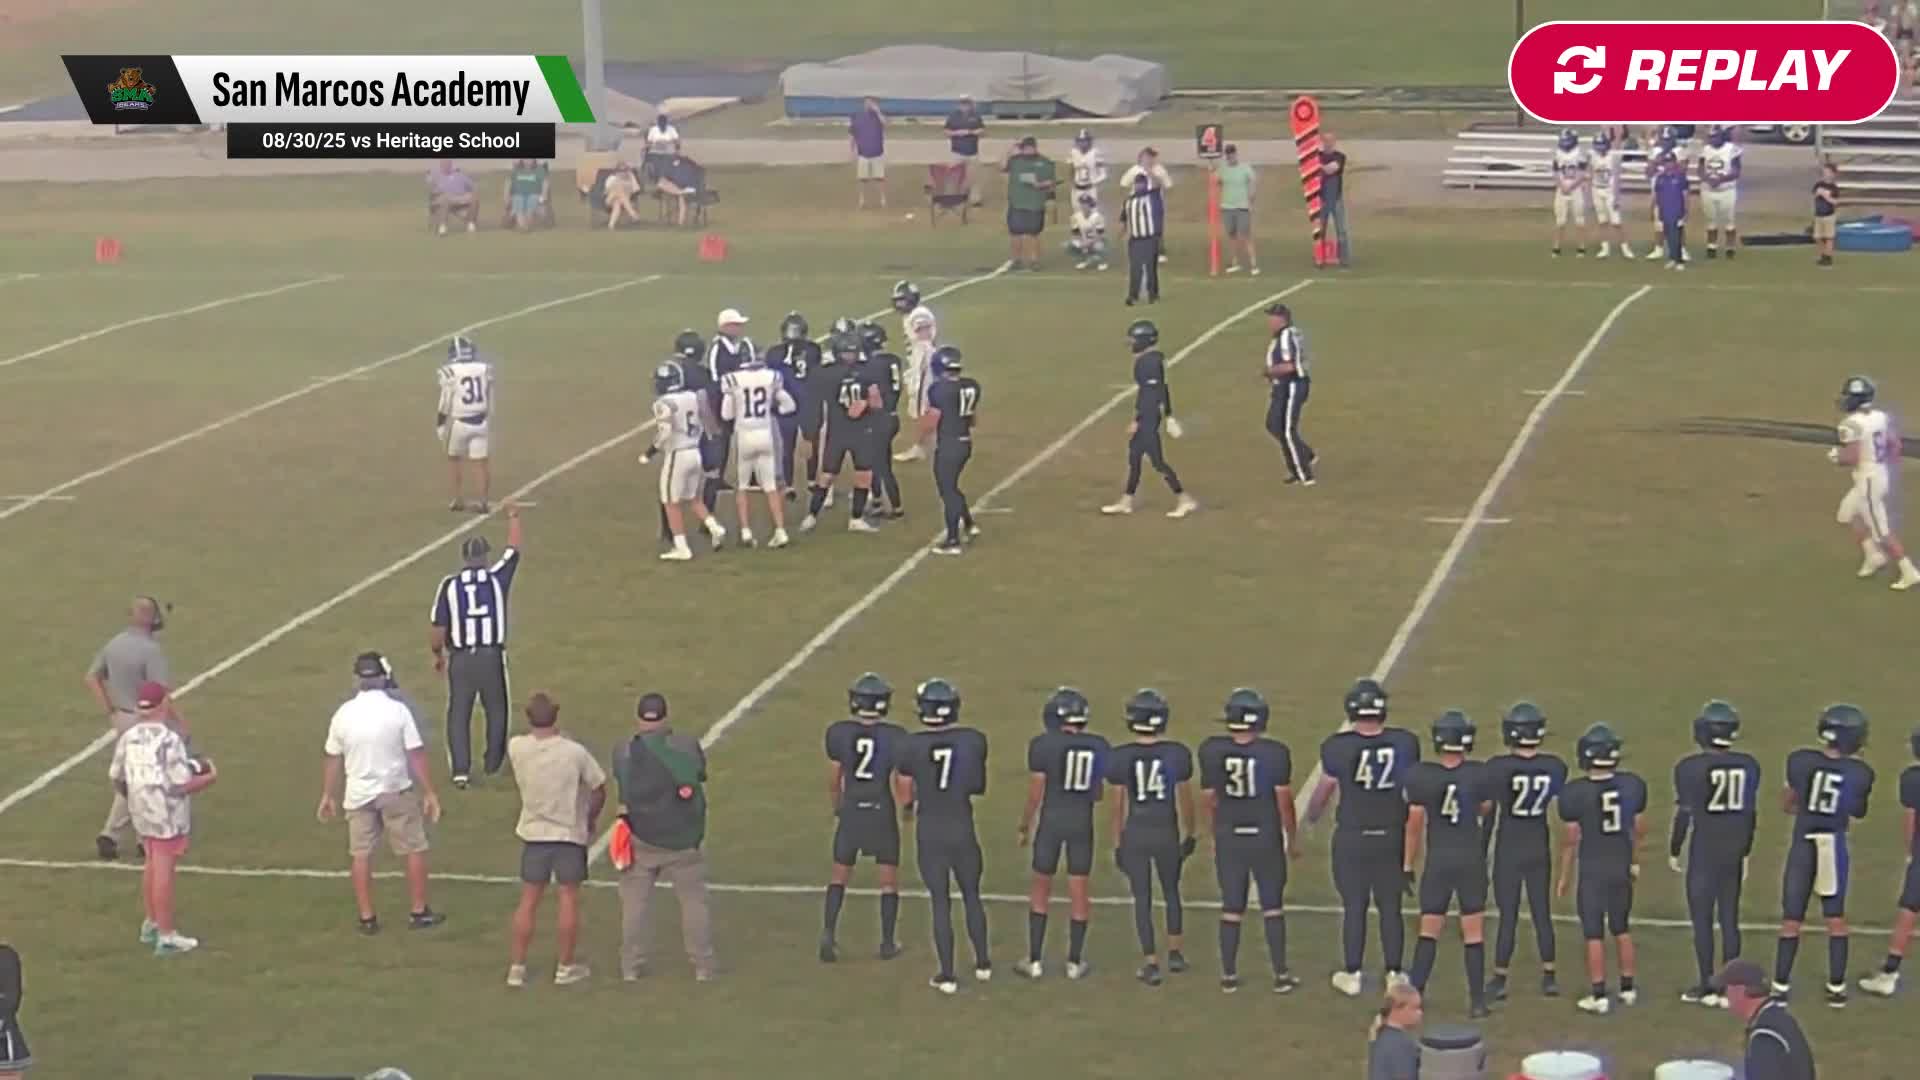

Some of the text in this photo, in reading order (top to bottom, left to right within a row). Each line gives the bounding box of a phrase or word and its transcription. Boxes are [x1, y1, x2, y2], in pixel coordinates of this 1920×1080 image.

[1202, 126, 1217, 152] 4
[461, 376, 483, 404] 31
[743, 387, 767, 418] 12
[464, 584, 488, 616] L
[855, 738, 874, 779] 2
[933, 749, 952, 789] 7
[1064, 749, 1094, 791] 10
[1225, 757, 1256, 797] 31
[1355, 747, 1395, 790] 42
[1135, 759, 1165, 801] 14
[1511, 775, 1551, 817] 22
[1707, 768, 1746, 812] 20
[1807, 770, 1843, 814] 15
[1441, 784, 1460, 824] 4
[1602, 791, 1622, 833] 5
